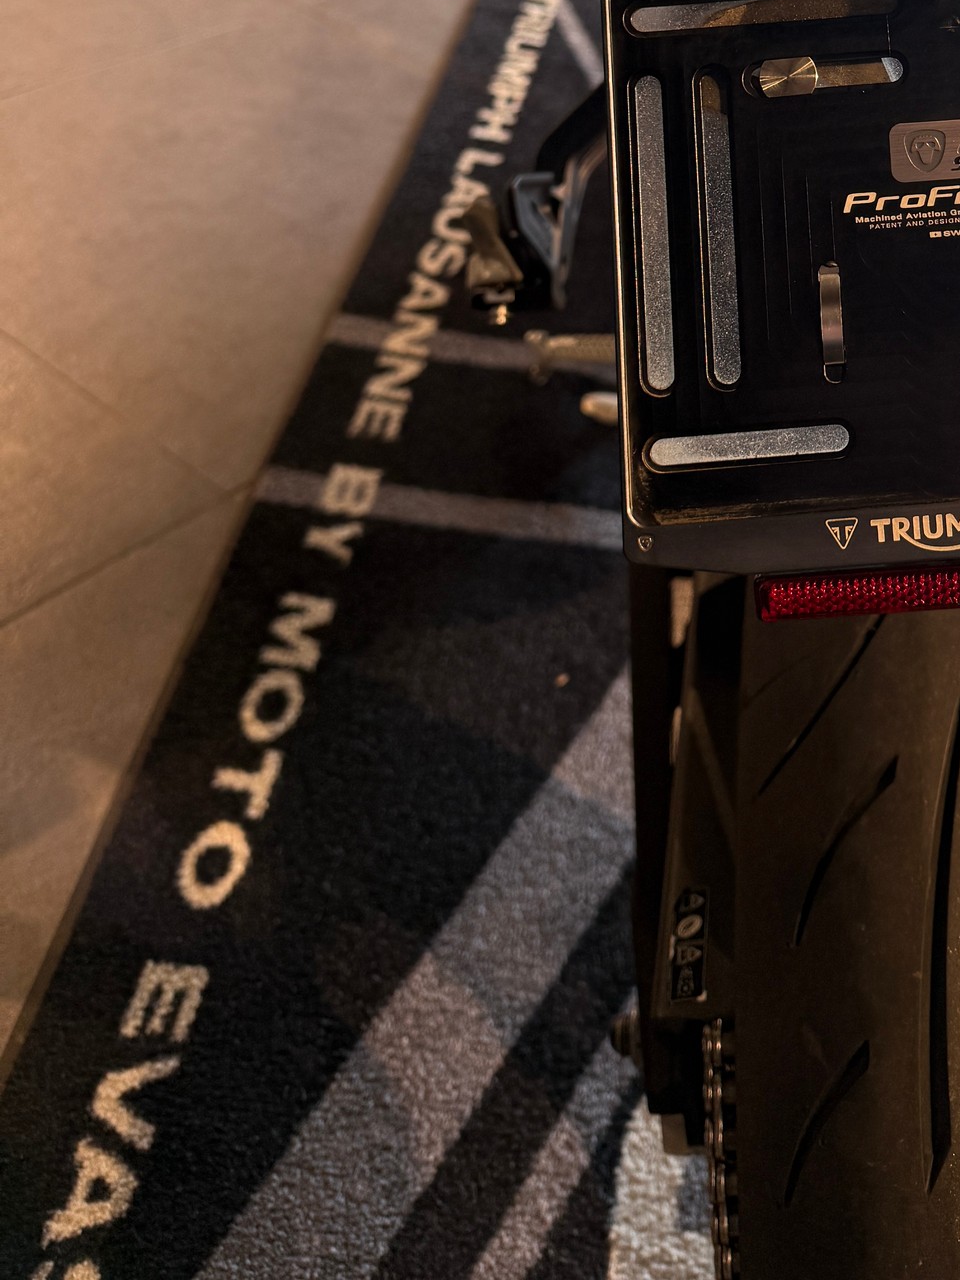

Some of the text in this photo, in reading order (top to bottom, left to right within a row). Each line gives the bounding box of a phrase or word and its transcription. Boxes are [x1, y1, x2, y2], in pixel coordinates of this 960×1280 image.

[346, 148, 506, 442] LAUSANNE
[855, 213, 902, 224] Machined
[906, 209, 947, 220] Aviation
[869, 221, 902, 230] PATENT
[928, 217, 960, 226] DESIGN
[303, 464, 384, 567] BY
[176, 592, 336, 910] MOTO
[28, 959, 210, 1280] EVA
